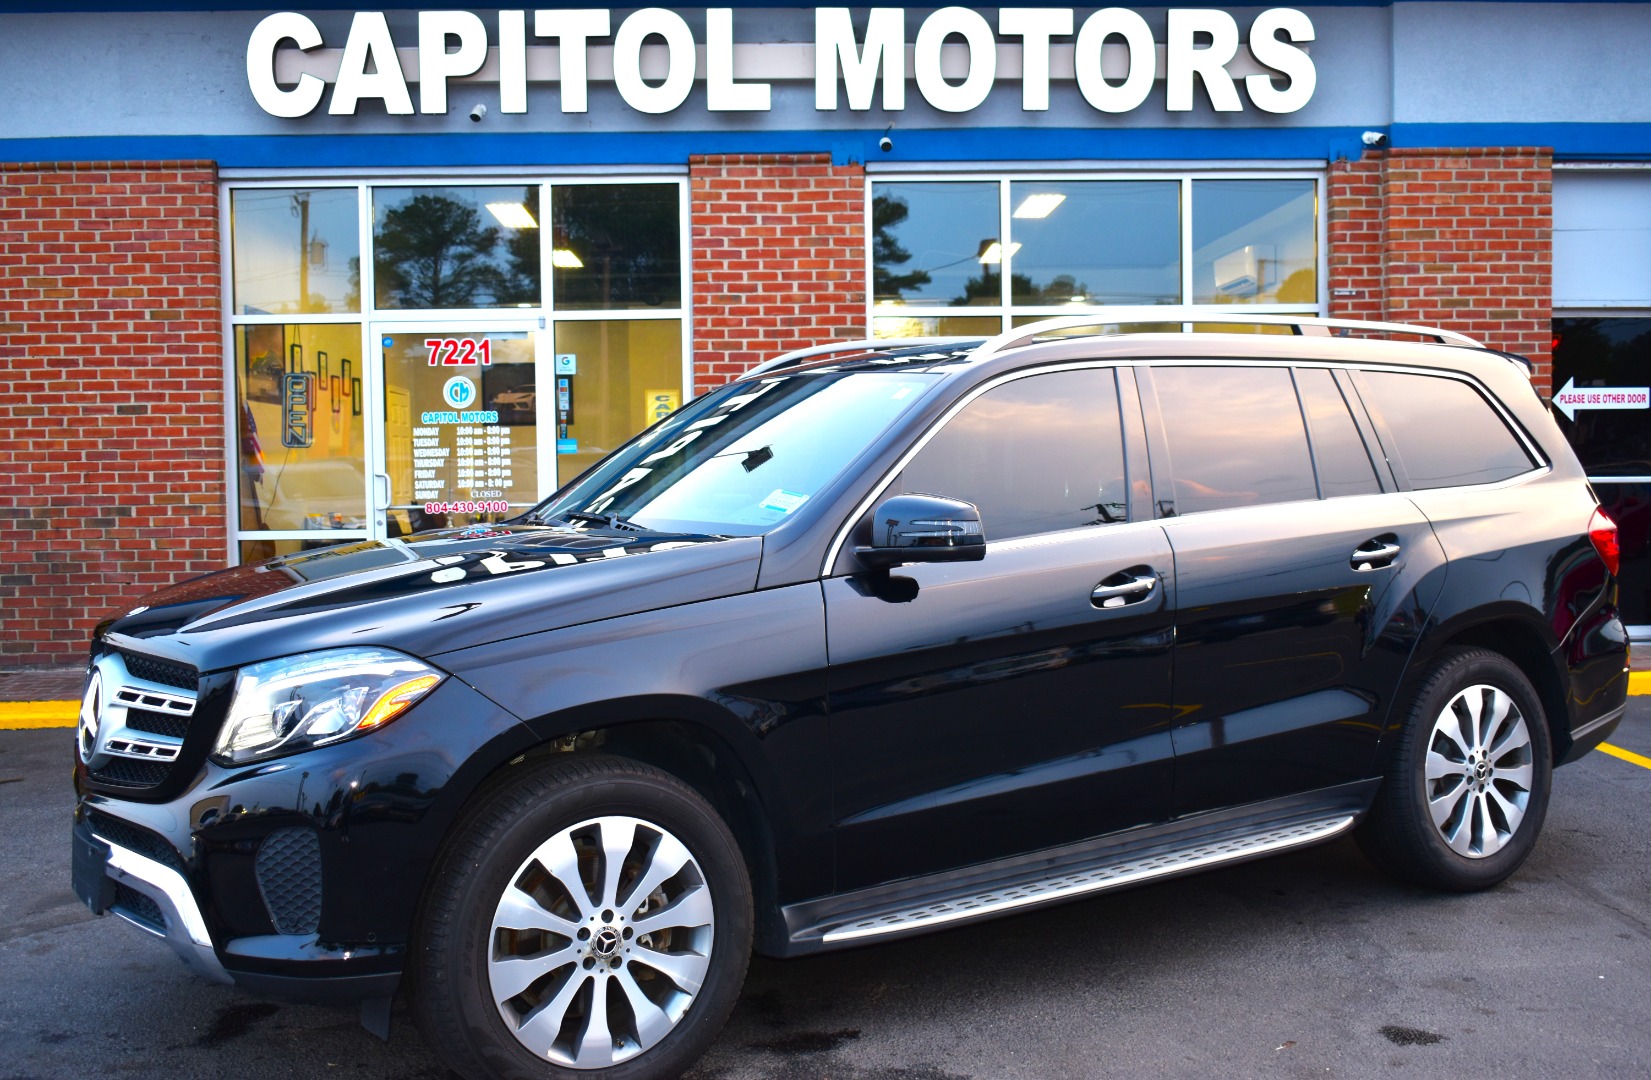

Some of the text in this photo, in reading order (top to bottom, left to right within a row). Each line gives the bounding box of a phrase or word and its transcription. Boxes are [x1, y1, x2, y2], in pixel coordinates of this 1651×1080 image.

[246, 6, 1317, 118] CAPITOL MOTORS
[425, 338, 491, 366] 7221
[1560, 394, 1646, 404] PLEASE USE OTHER DOOR
[288, 378, 307, 444] OPEN
[422, 411, 498, 424] CAPITOL MOTORS
[414, 428, 439, 436] MONDAY
[414, 438, 439, 446] TUESDAY
[414, 448, 449, 457] WEDNESDAY
[414, 459, 444, 467] THURSDAY
[415, 470, 435, 478] FRIDAY
[415, 480, 444, 489] SATURDAY
[416, 491, 438, 499] SUNDAY
[425, 501, 508, 514] 804-430-9100
